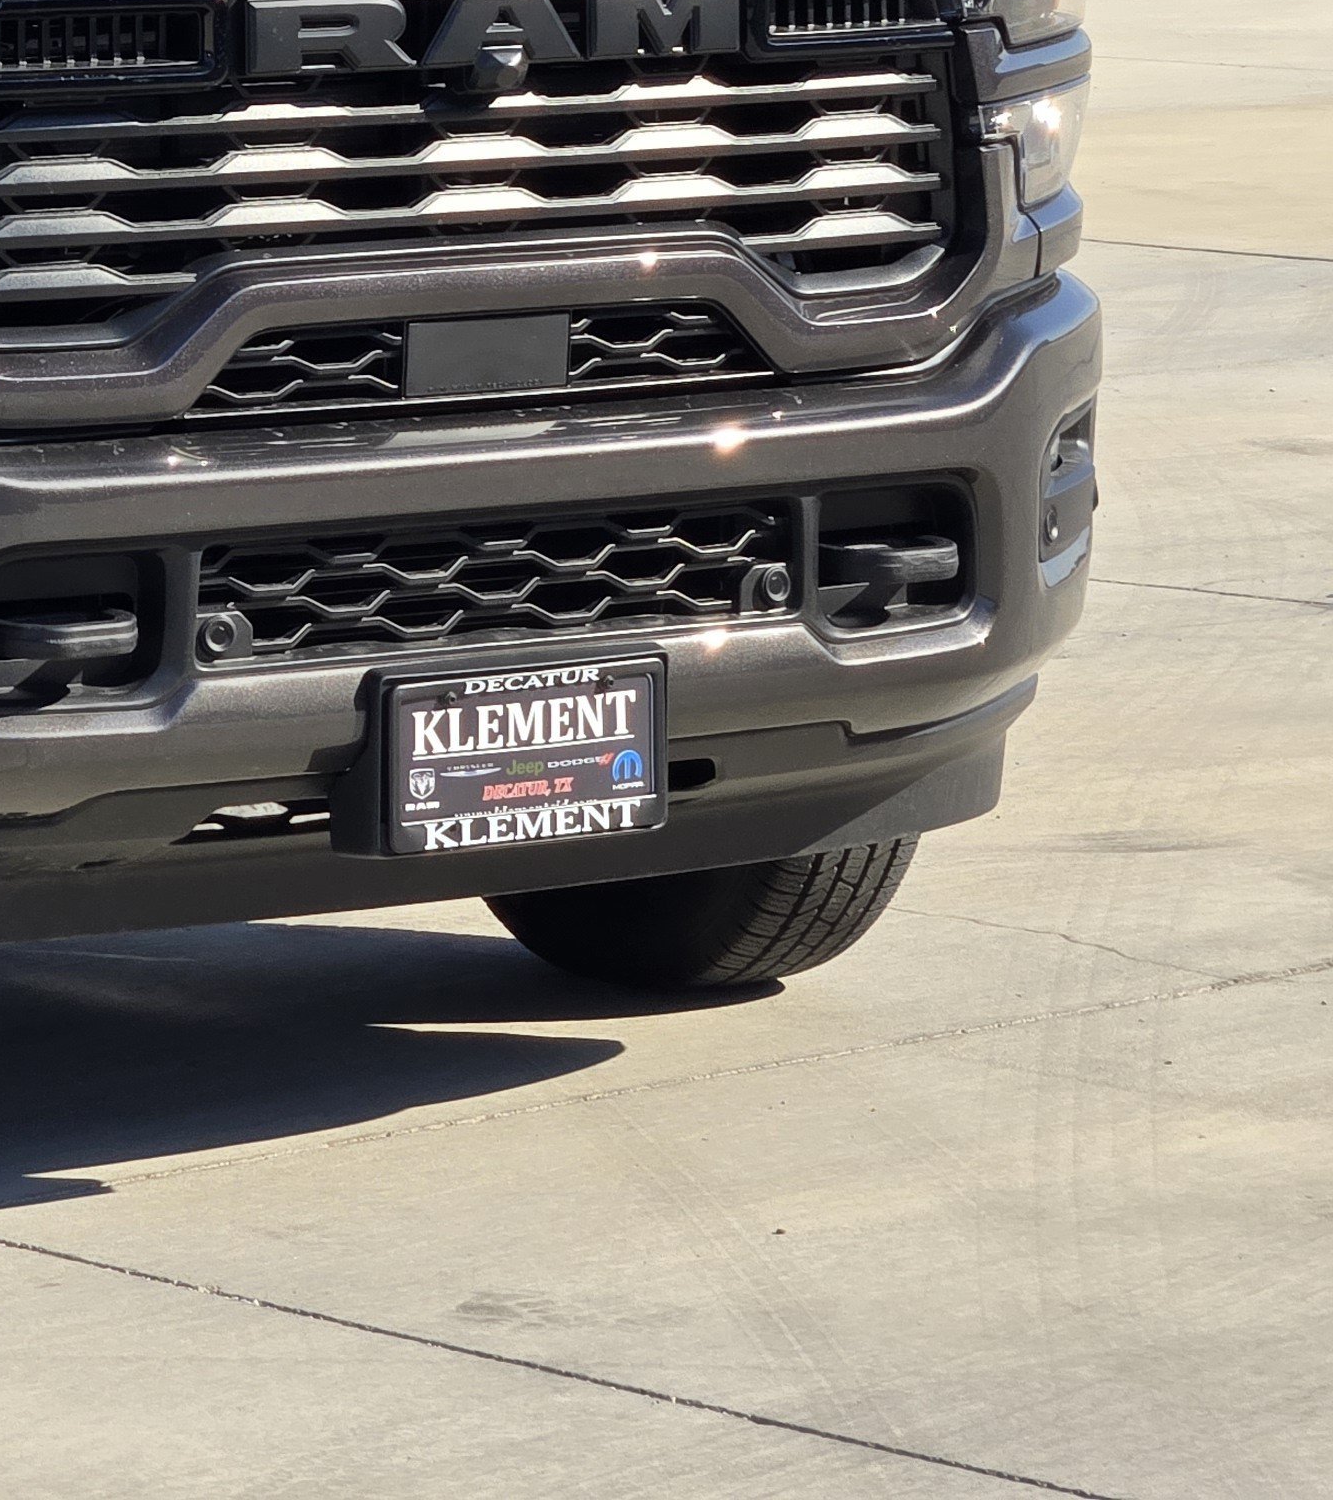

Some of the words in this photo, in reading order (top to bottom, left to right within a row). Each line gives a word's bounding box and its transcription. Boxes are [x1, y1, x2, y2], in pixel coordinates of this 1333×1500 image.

[464, 668, 600, 695] DECATUR
[412, 689, 636, 757] KLEMENT
[506, 759, 544, 776] Jeep
[482, 780, 551, 801] DECATUR,
[554, 777, 574, 793] TX
[423, 799, 640, 851] KLEMENT
